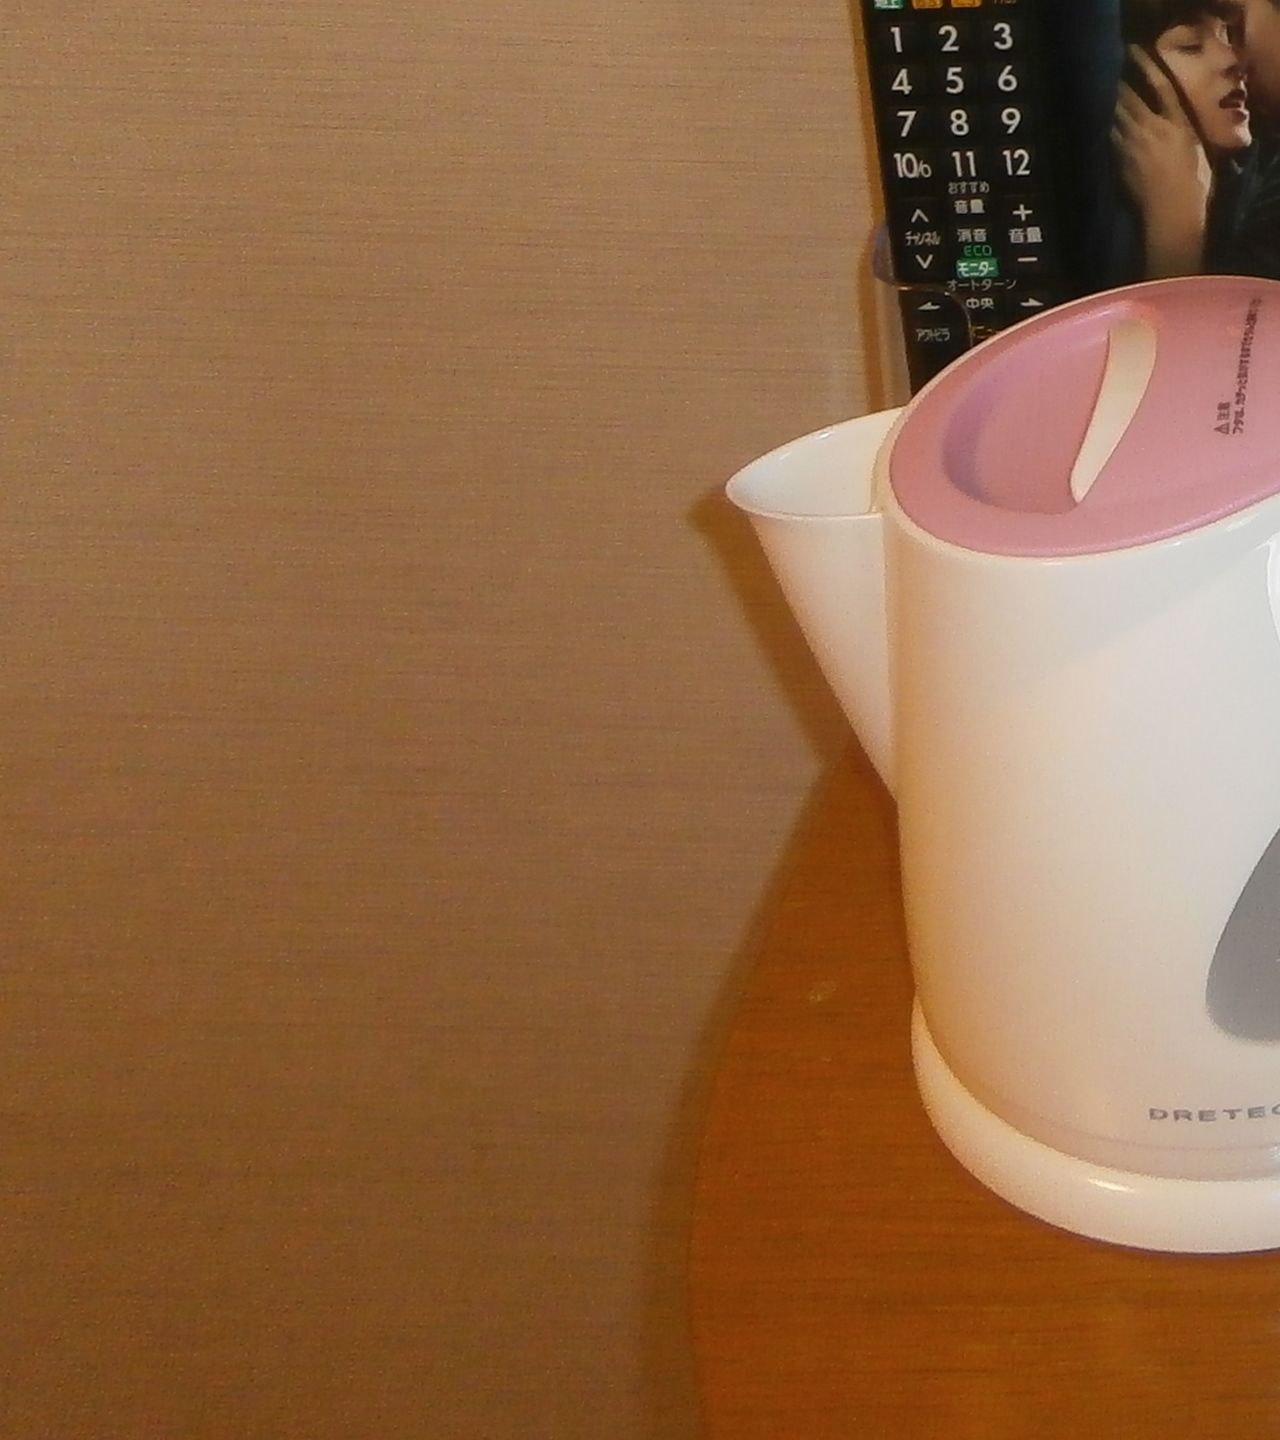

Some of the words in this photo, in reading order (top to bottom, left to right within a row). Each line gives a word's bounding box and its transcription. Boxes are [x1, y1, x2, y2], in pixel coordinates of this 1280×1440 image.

[890, 26, 903, 53] 1
[938, 25, 960, 52] 2
[993, 22, 1013, 50] 3
[891, 68, 913, 95] 4
[946, 66, 964, 94] 5
[997, 65, 1018, 92] 6
[896, 111, 917, 137] 7
[950, 109, 969, 136] 8
[1001, 107, 1021, 134] 9
[951, 150, 977, 177] 11
[1002, 148, 1031, 176] 12
[948, 181, 990, 195] おすすめ
[954, 198, 985, 214] 音量
[957, 228, 987, 243] 消音
[1008, 226, 1043, 244] 音量
[963, 245, 992, 256] ECO
[957, 261, 996, 277] モニター
[946, 279, 1017, 292] オートターン
[965, 297, 995, 309] 中央
